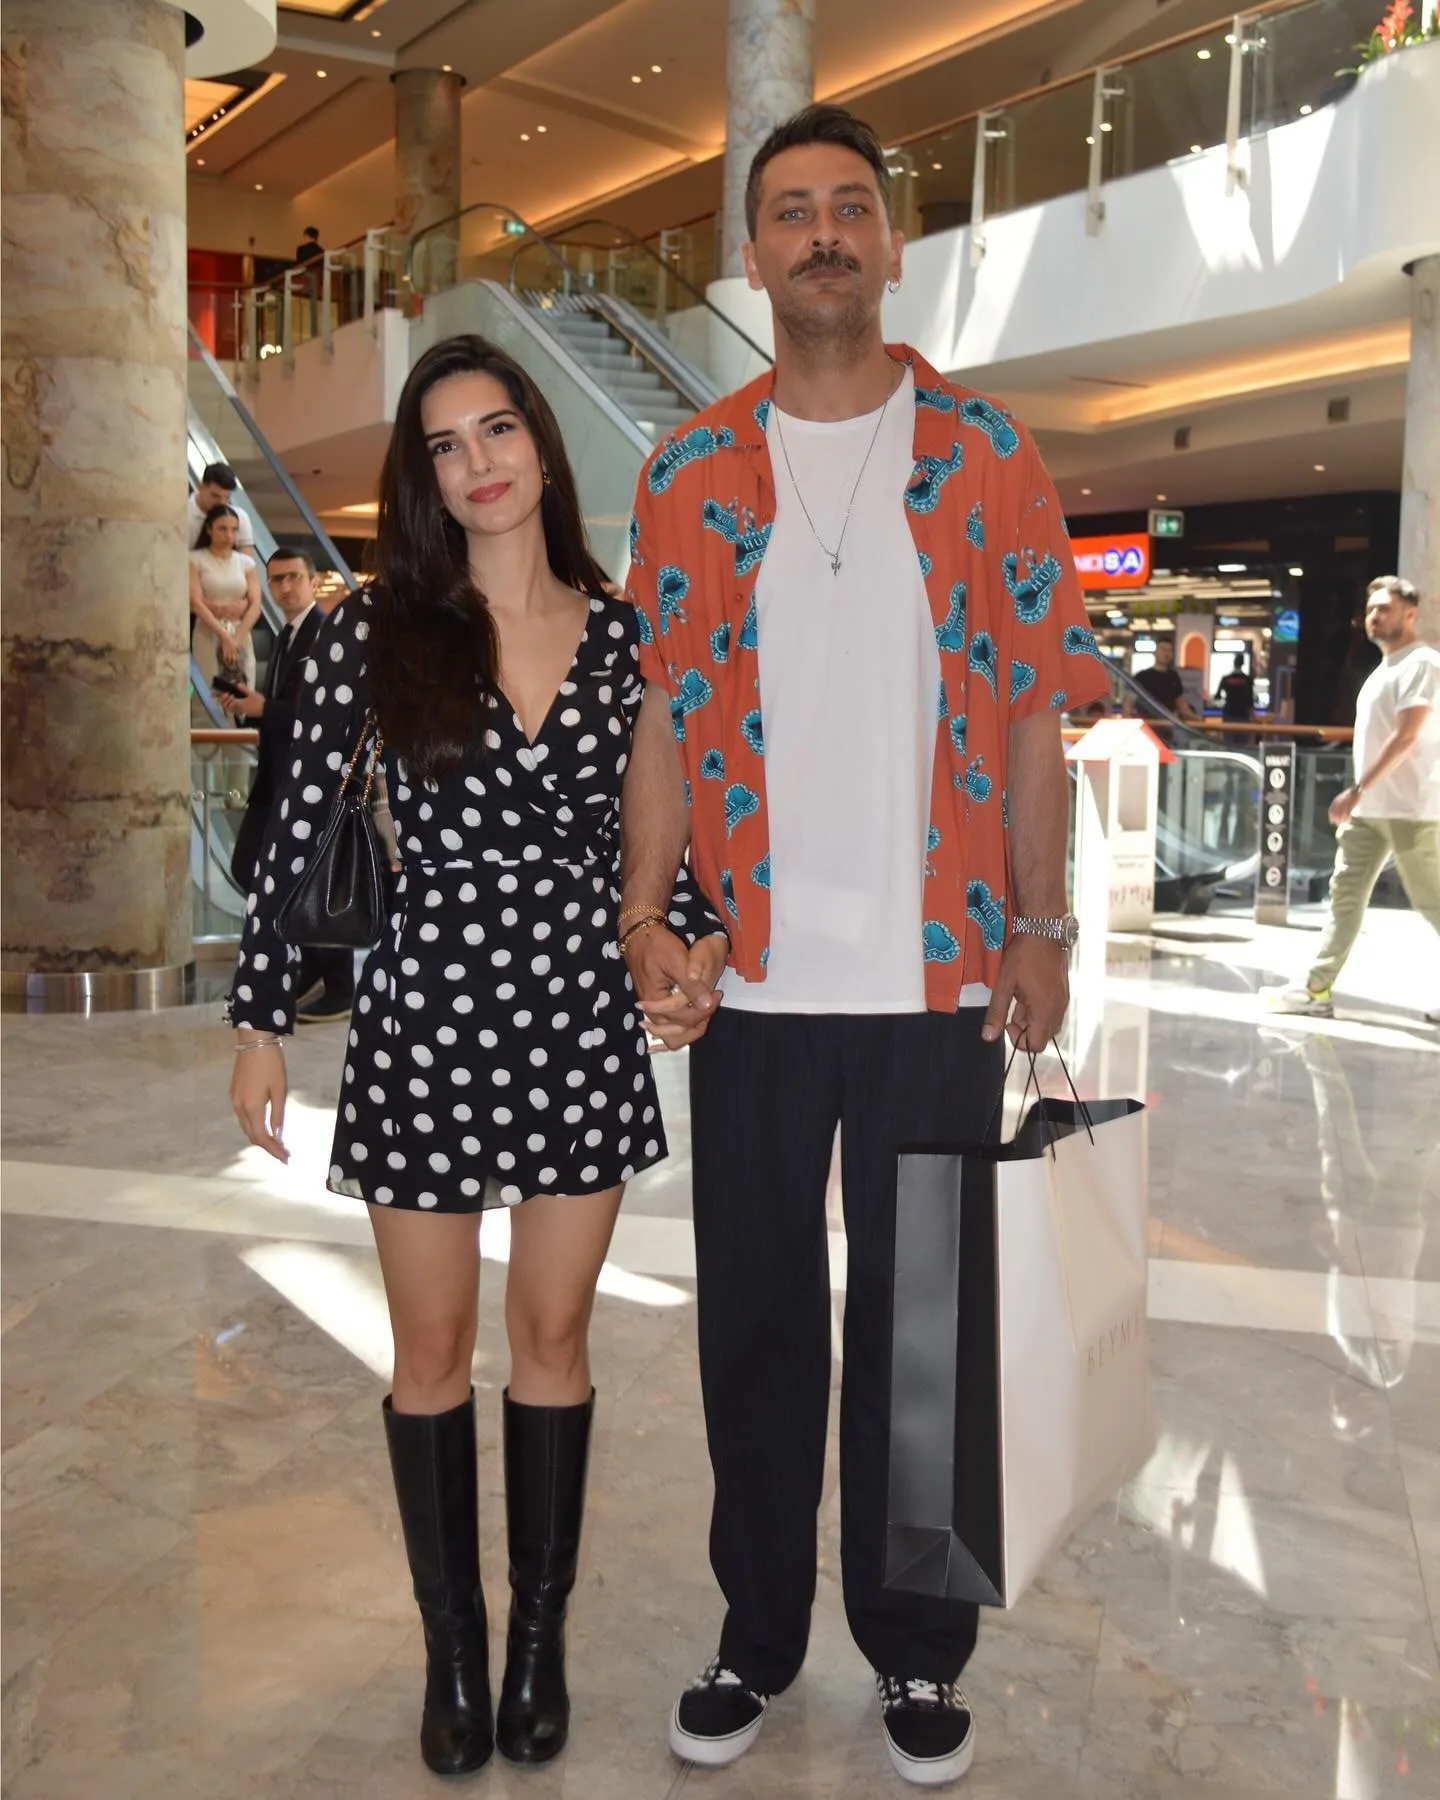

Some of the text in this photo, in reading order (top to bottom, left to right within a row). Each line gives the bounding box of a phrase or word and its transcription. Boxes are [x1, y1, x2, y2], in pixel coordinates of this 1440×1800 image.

[1073, 550, 1140, 571] NOSA
[1031, 569, 1051, 591] HU
[1081, 635, 1095, 646] HU
[679, 686, 693, 701] UF
[725, 799, 738, 813] UF
[980, 902, 1000, 925] HUF
[1087, 1306, 1144, 1378] BEYME
